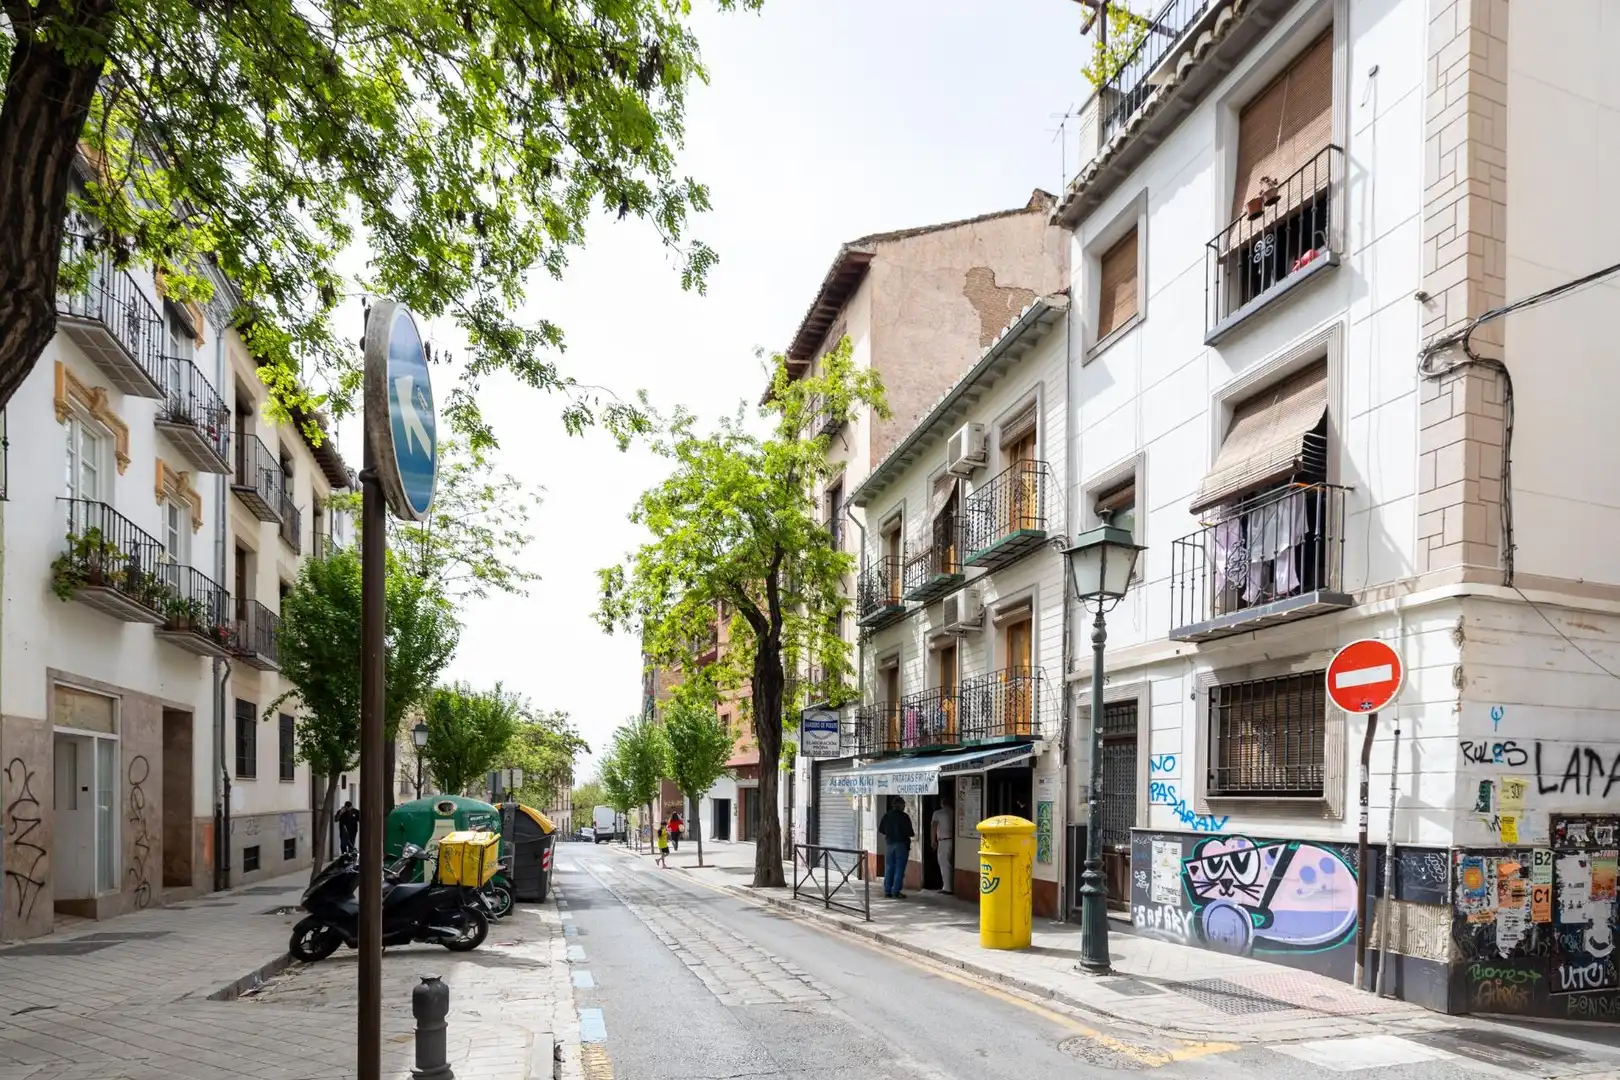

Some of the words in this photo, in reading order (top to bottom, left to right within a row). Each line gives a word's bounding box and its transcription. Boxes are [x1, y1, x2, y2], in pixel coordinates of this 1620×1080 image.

[1150, 755, 1176, 772] NO
[892, 773, 915, 783] PATATAS
[1534, 851, 1552, 866] B2
[1533, 888, 1550, 903] C1
